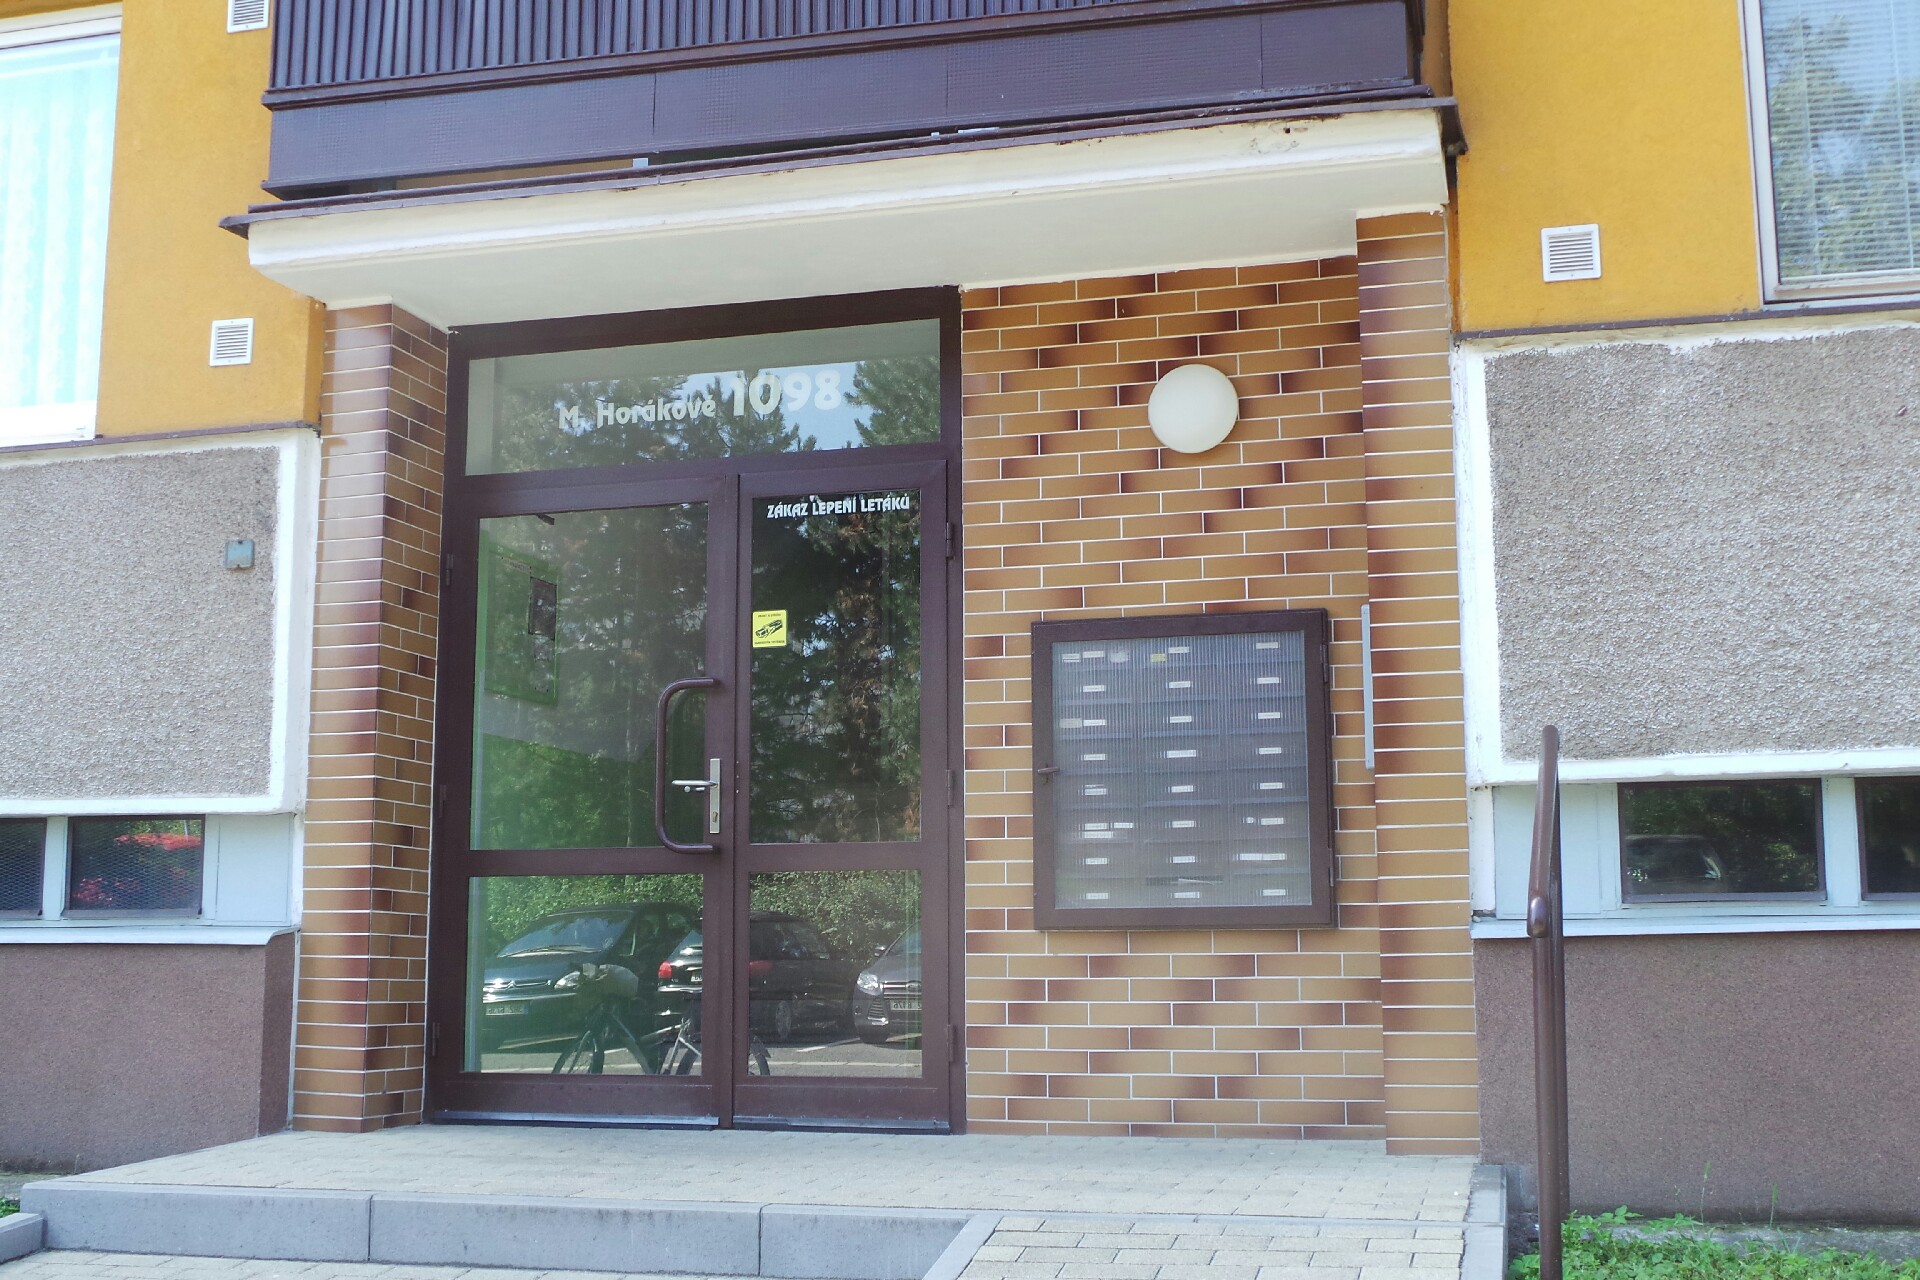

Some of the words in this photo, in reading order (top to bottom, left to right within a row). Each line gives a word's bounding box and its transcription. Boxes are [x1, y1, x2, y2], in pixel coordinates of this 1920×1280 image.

[597, 394, 716, 428] Horákové
[730, 370, 841, 416] 1098
[767, 501, 809, 519] ZÁKAZ
[812, 496, 857, 516] LEPENÍ
